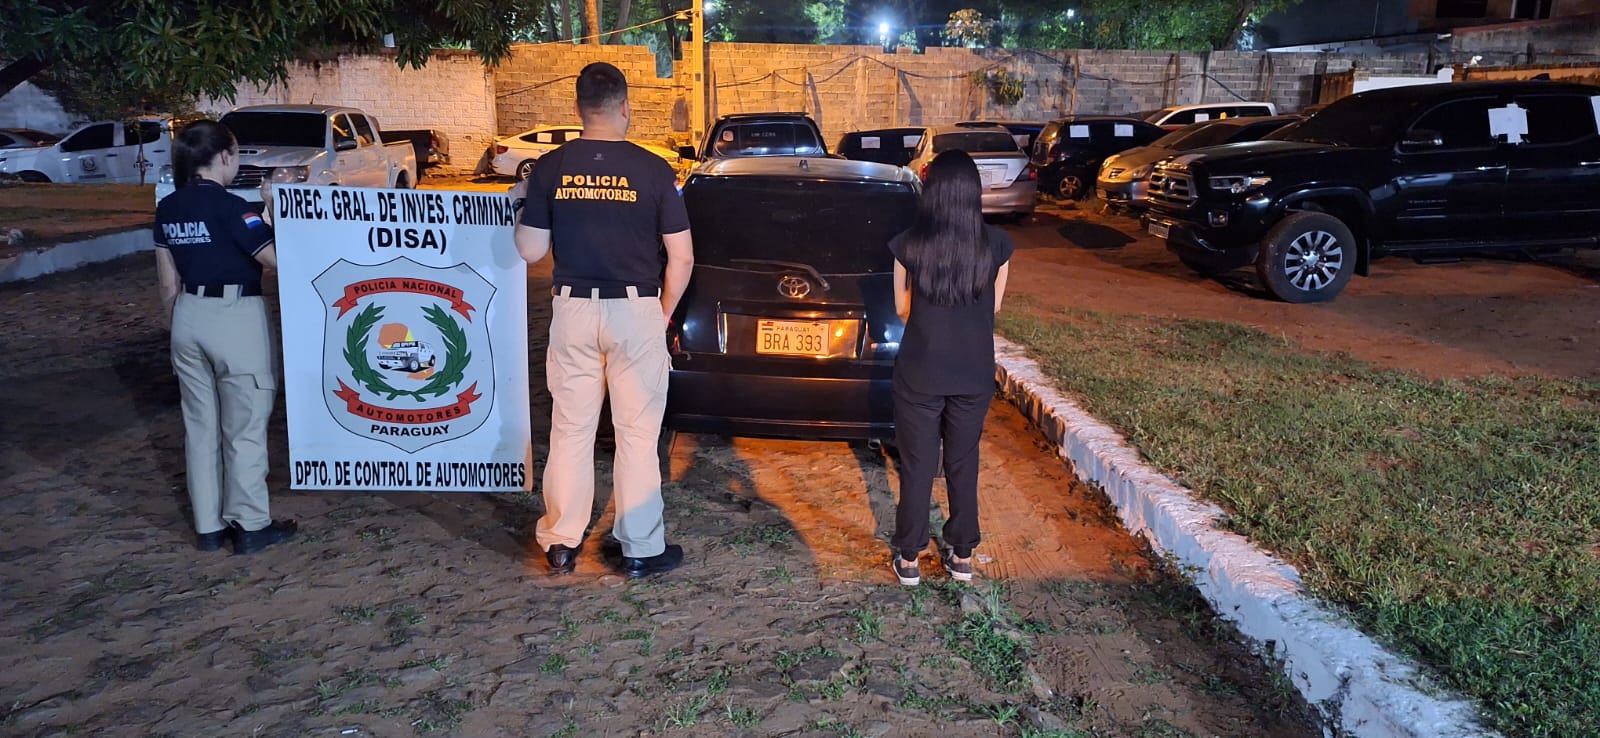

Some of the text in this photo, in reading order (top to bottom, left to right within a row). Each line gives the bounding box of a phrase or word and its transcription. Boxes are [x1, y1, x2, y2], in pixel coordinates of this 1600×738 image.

[562, 175, 629, 188] POLICIA
[555, 188, 637, 202] AUTOMOTORES
[279, 188, 517, 226] DIREC. GRAL. DE INVES. CRIMINA
[161, 221, 210, 239] POLICIA
[368, 226, 447, 255] (DISA)
[353, 281, 457, 297] POLICIA NACIONAL
[777, 325, 810, 333] PARAGUAY
[764, 333, 822, 351] BRA 393
[356, 404, 461, 422] AUTOMOTORES
[370, 424, 450, 437] PARAGUAY
[295, 460, 526, 488] DPTO. DE CONTROL DE AUTOMOTORES
